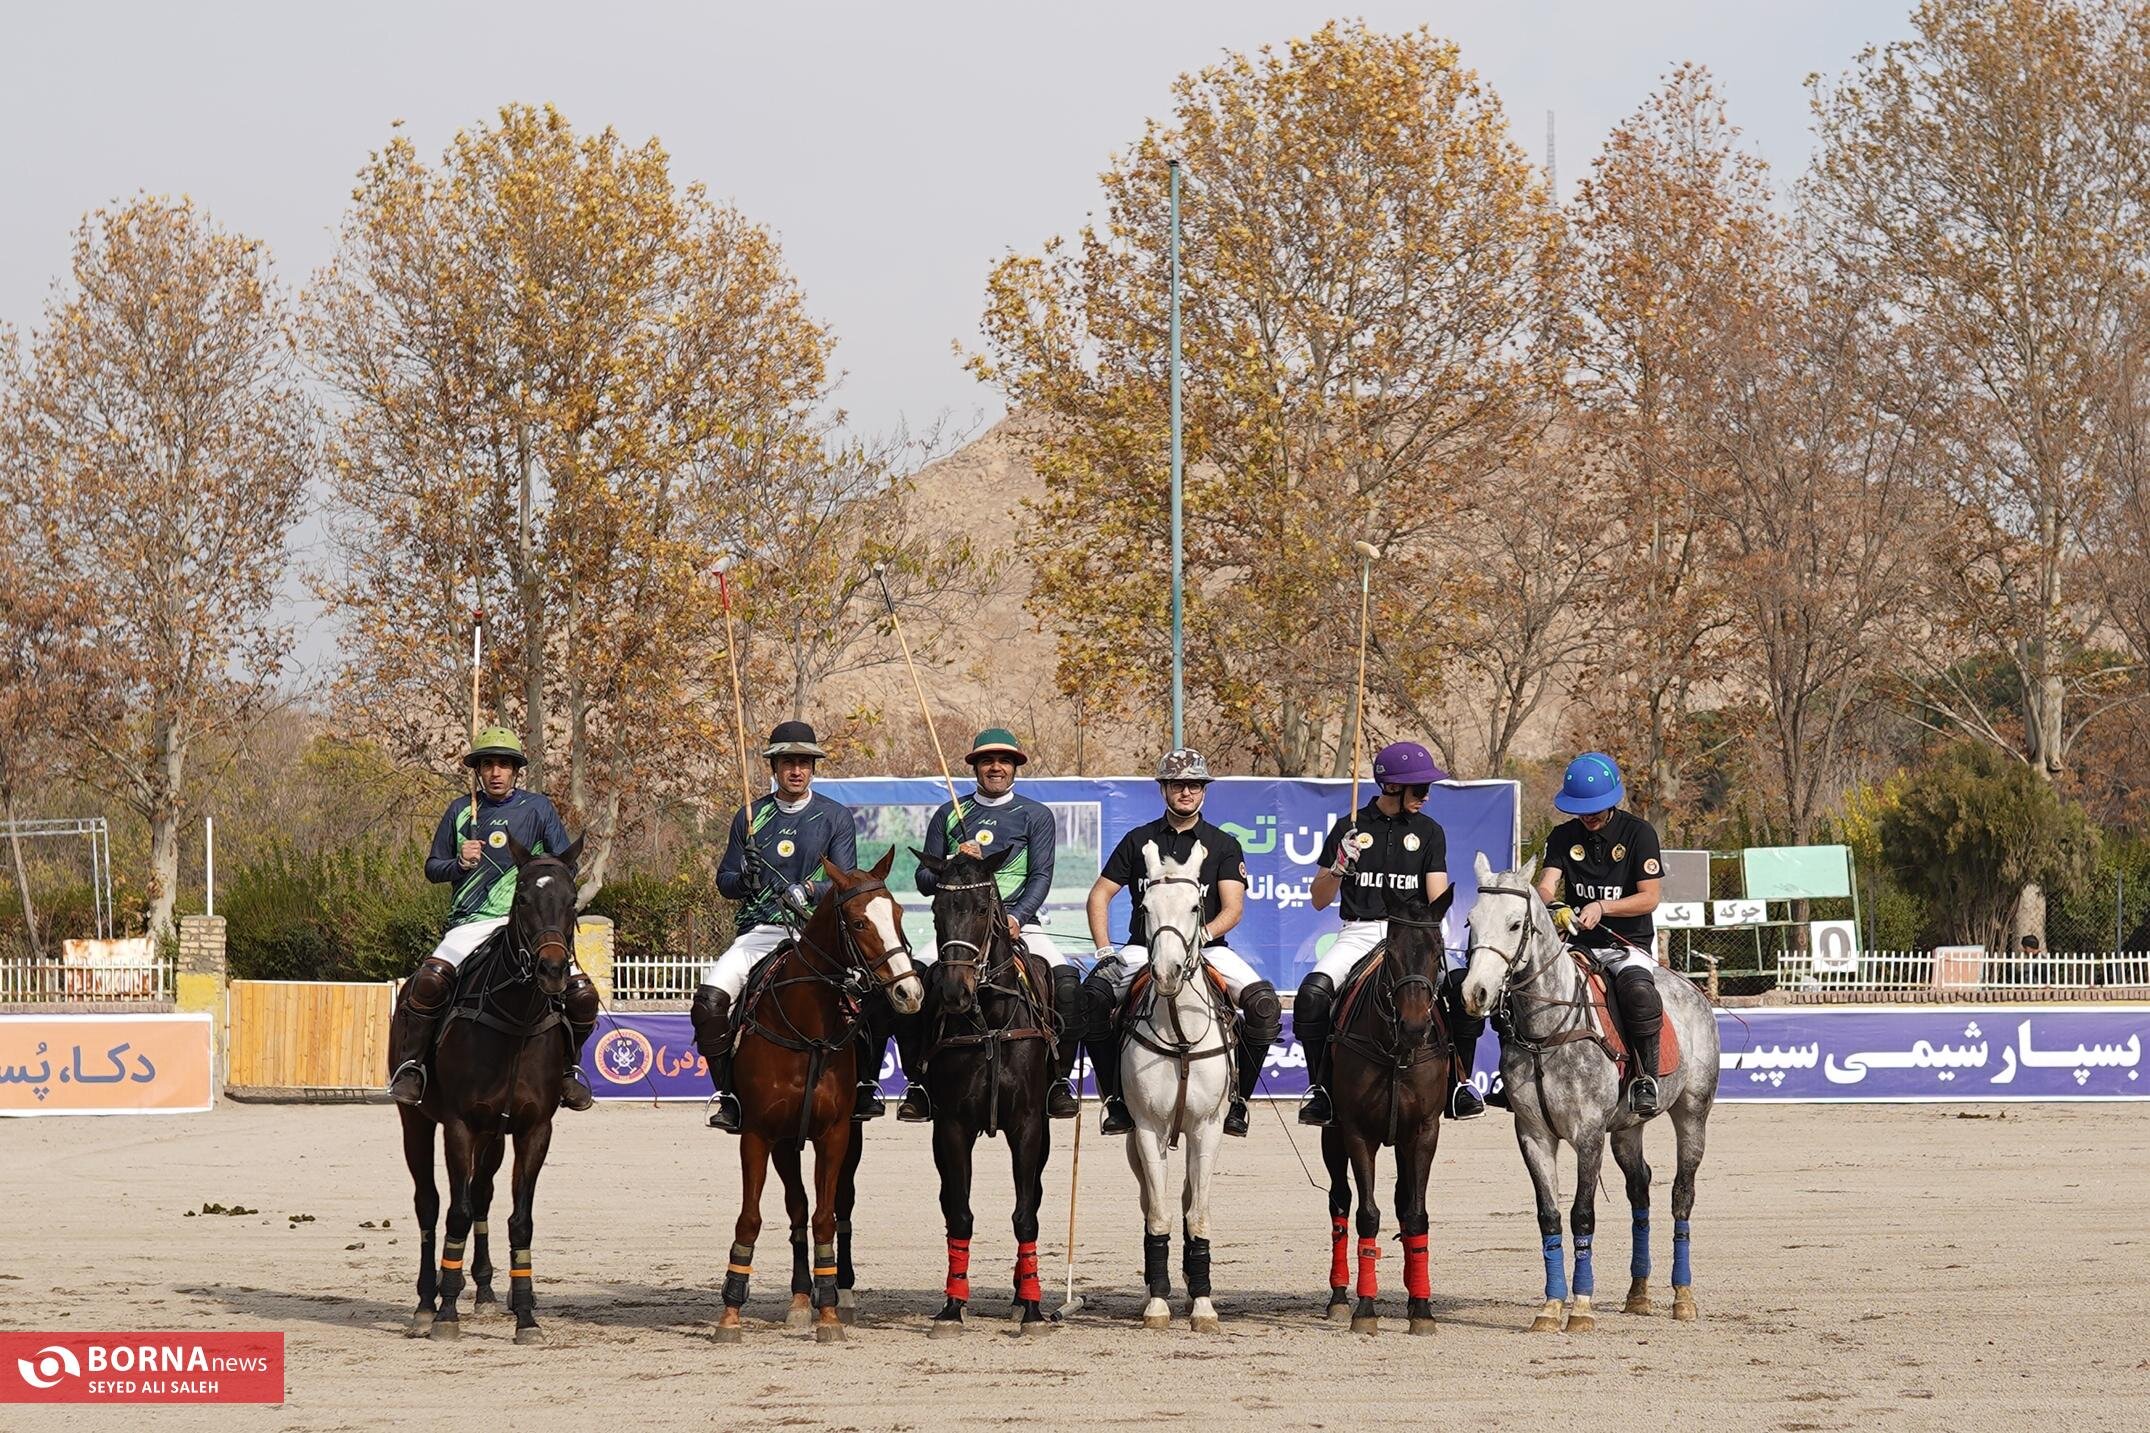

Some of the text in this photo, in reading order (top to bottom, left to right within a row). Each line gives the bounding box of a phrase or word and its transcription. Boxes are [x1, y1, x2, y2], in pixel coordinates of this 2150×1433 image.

[1388, 873, 1419, 890] TEAM
[1571, 882, 1624, 901] OLO TEA
[1819, 926, 1851, 967] 0
[1824, 1020, 1989, 1085] شیمی
[1990, 1019, 2142, 1087] بسپار
